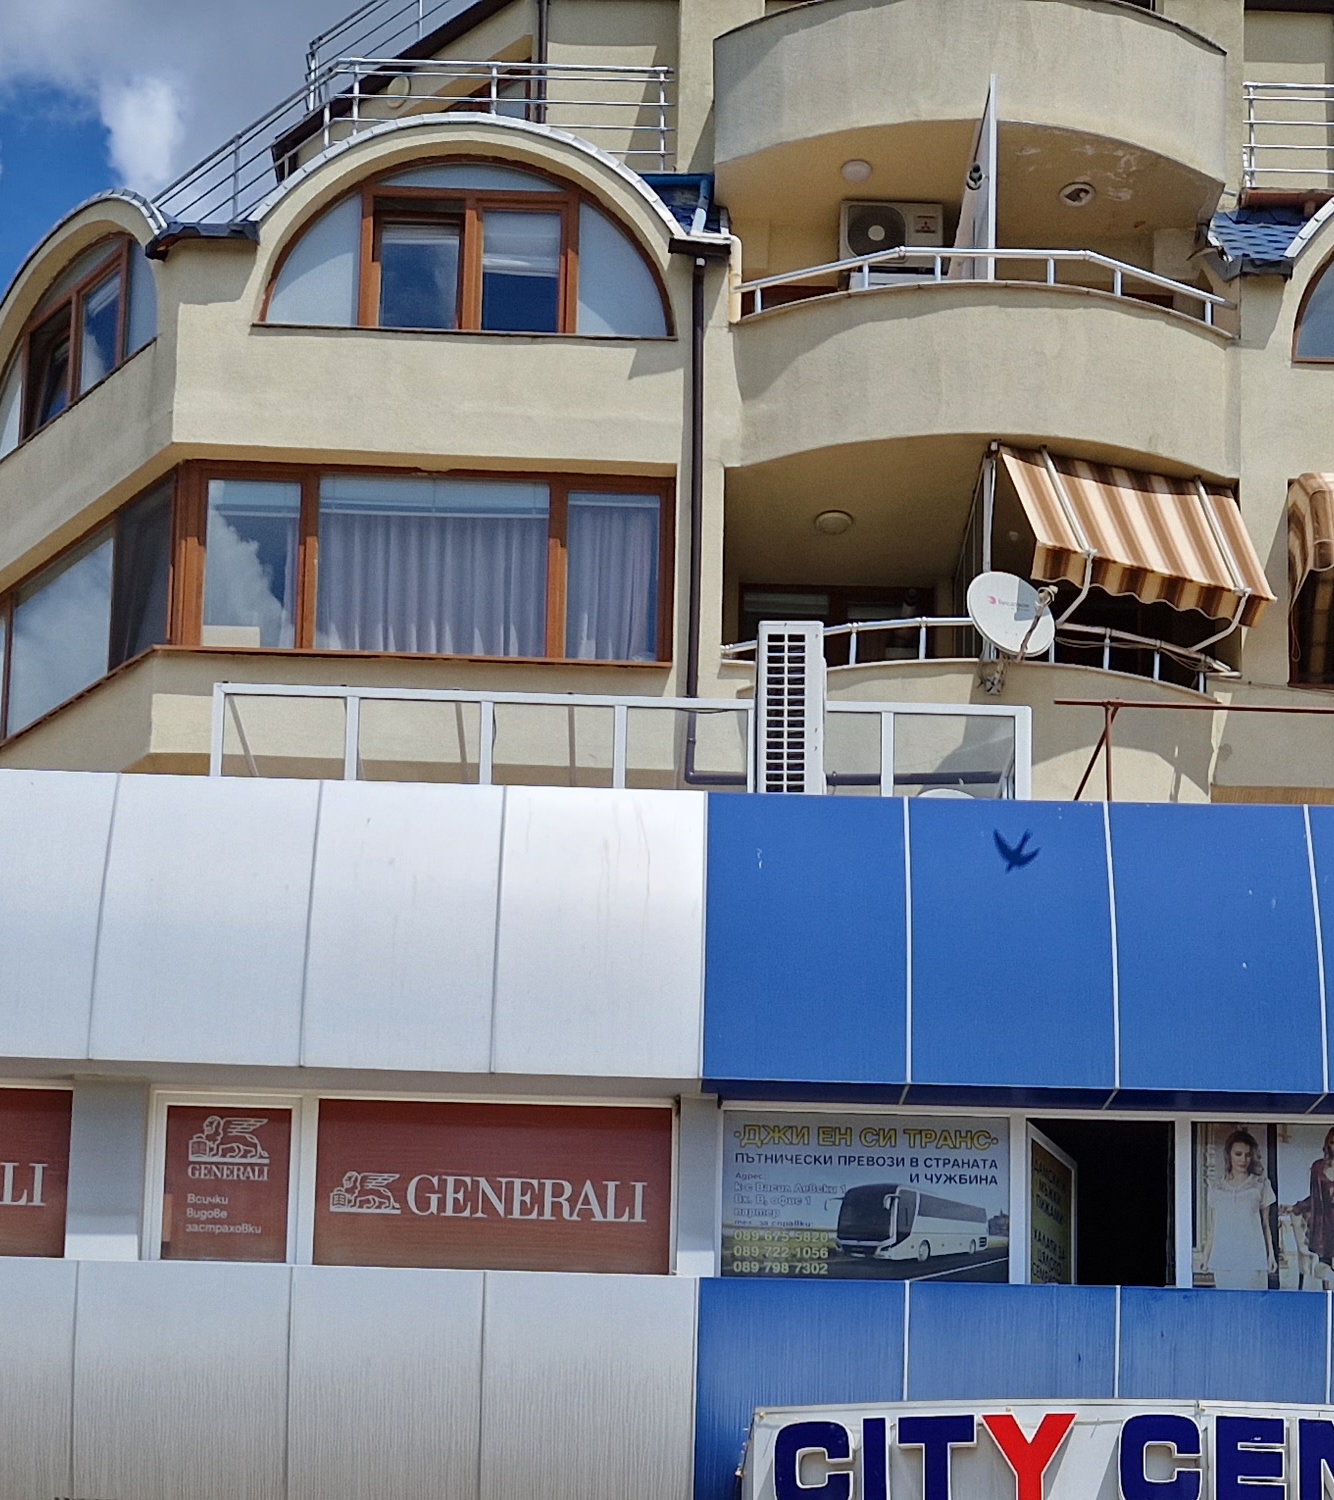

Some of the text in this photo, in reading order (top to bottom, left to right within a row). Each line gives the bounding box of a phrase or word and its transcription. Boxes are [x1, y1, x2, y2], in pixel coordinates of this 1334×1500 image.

[740, 1124, 992, 1151] ДЖИ ЕН СИ ТРАНС
[734, 1152, 999, 1170] ПЪТНИЧЕСКИ ПРЕВОЗИ В СТРАНАТА
[186, 1164, 269, 1182] GENERALI
[909, 1173, 999, 1186] И ЧУЖБИНА
[186, 1192, 229, 1206] Всички
[406, 1173, 649, 1224] GENERALI
[185, 1207, 228, 1221] видове
[185, 1221, 262, 1237] застраховки
[733, 1229, 829, 1243] 089 675 5820
[733, 1245, 829, 1259] 089 722 1056
[733, 1260, 829, 1275] 089 798 7302
